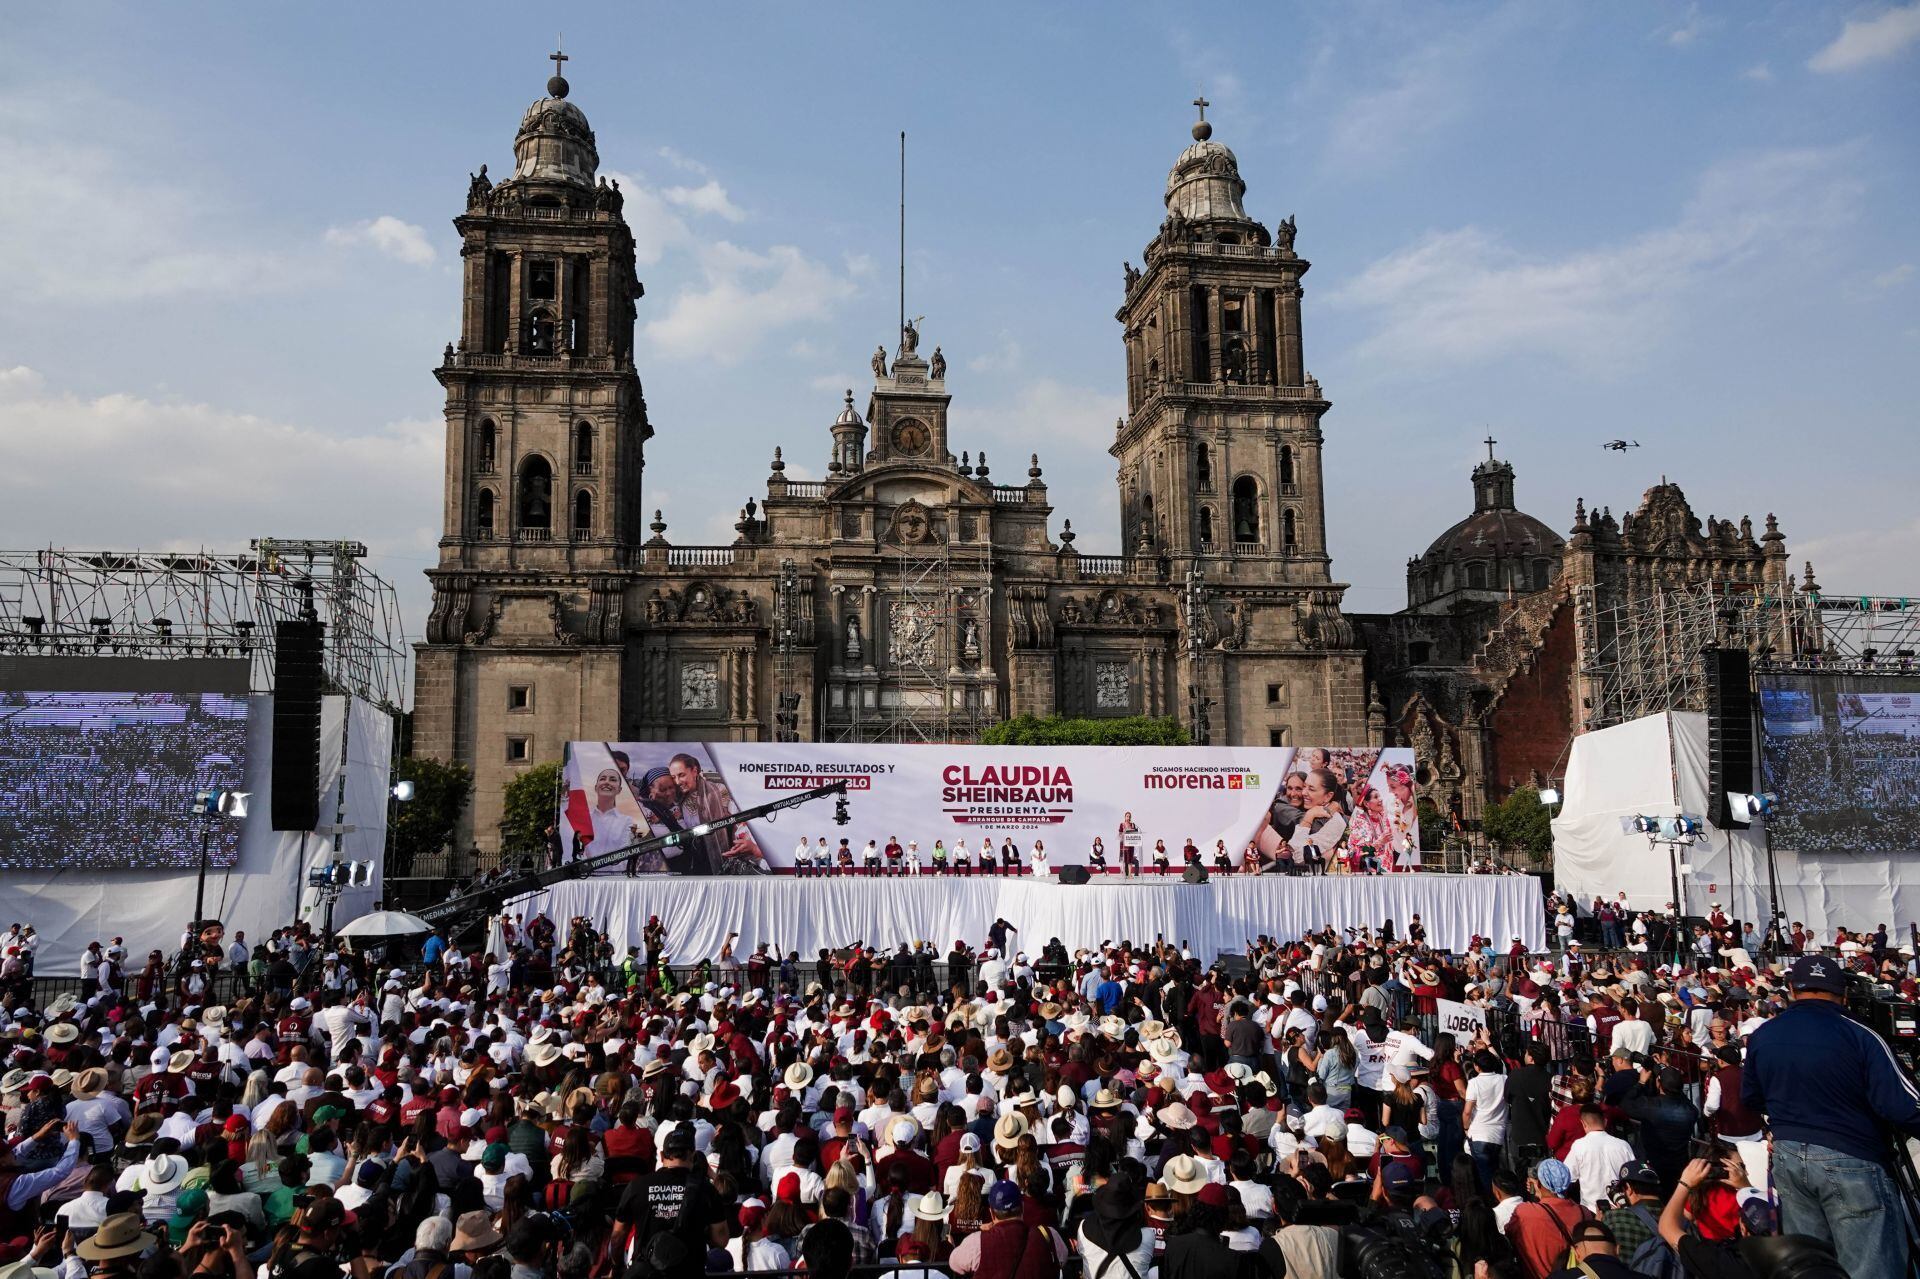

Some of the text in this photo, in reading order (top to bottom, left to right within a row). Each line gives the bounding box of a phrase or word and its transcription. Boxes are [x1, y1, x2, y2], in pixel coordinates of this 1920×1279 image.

[739, 763, 895, 774] HONESTIDAD, RESULTADOS Y
[942, 765, 1073, 786] CLAUDIA
[767, 777, 803, 788] AMOR
[805, 778, 820, 788] AL
[1144, 774, 1225, 789] morena
[1230, 780, 1241, 789] PT
[942, 786, 1073, 803] SHEINBAUM
[970, 806, 1047, 815] PRESIDENTA
[591, 848, 640, 867] VIRTUALMEDIA.MX
[648, 1185, 686, 1193] EDUARD
